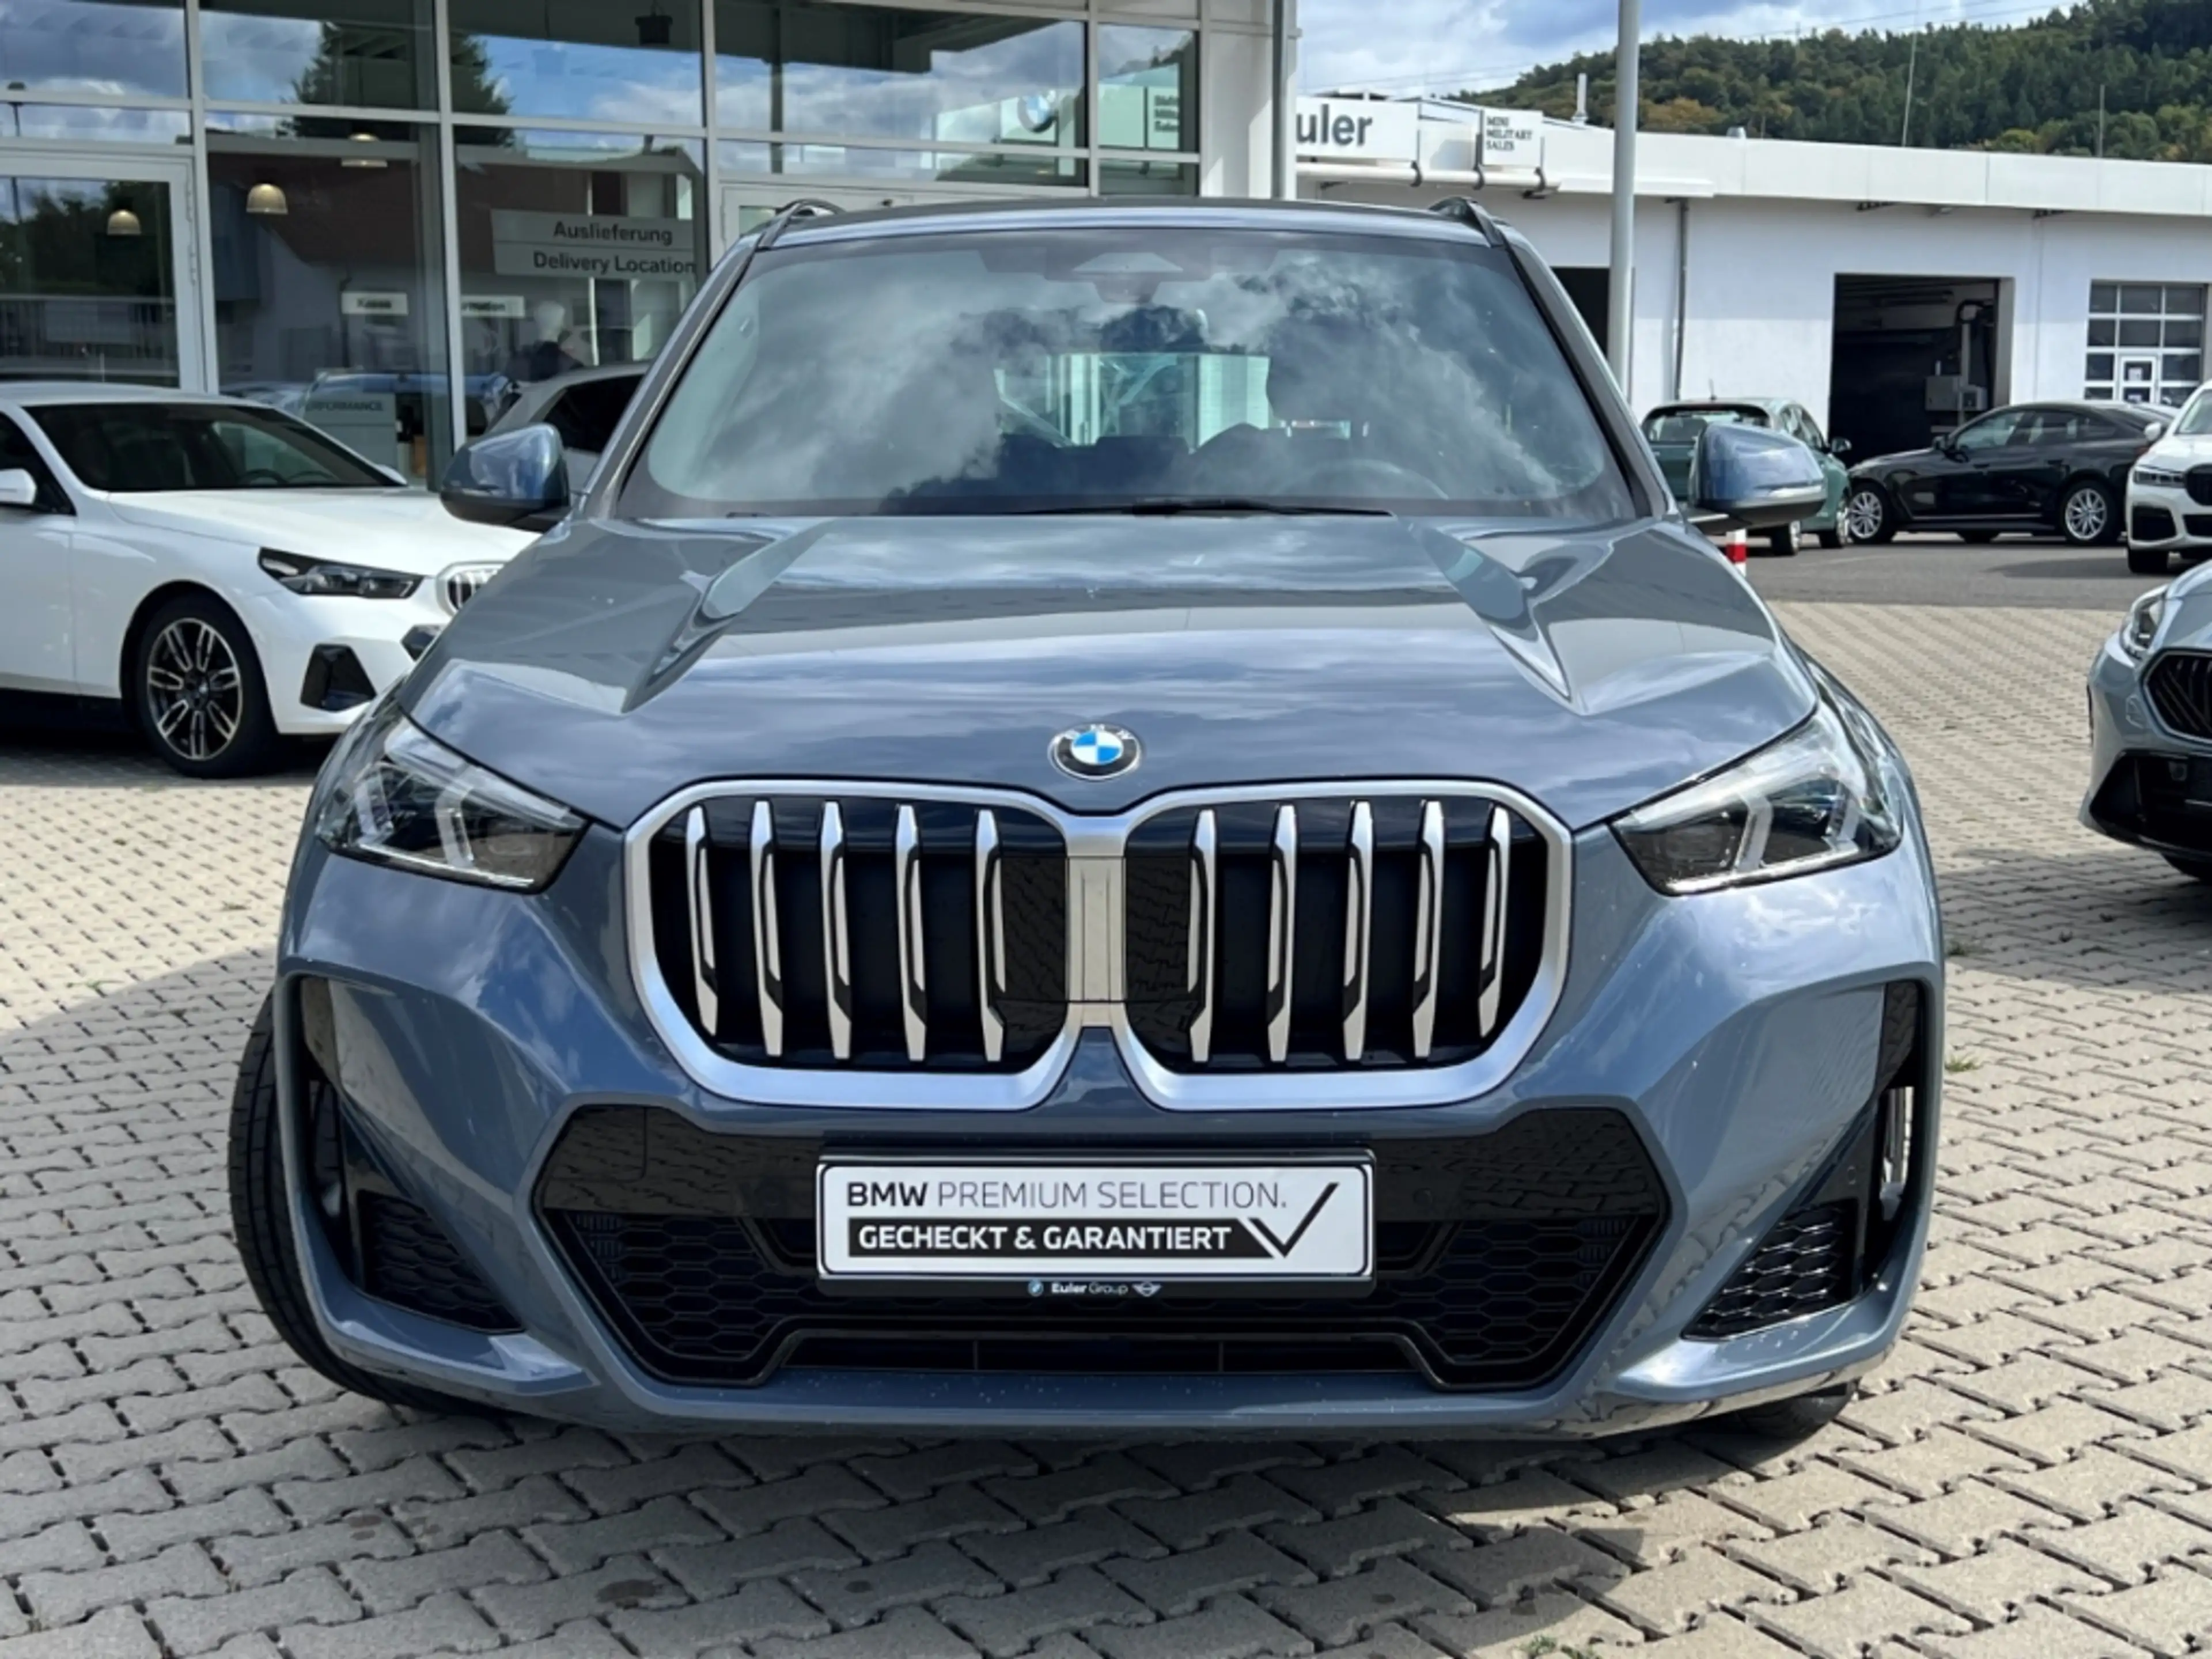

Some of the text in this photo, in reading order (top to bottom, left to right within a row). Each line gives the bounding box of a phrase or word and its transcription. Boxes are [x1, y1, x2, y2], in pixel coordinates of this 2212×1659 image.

[1296, 104, 1373, 146] uler
[553, 221, 673, 245] Auslieferung
[533, 251, 696, 274] Delivery Location
[848, 1182, 1287, 1209] BMW PREMIUM SELECTION.
[858, 1225, 1232, 1249] GECHECKT & GARANTIERT
[1051, 1283, 1128, 1295] Euler Group
